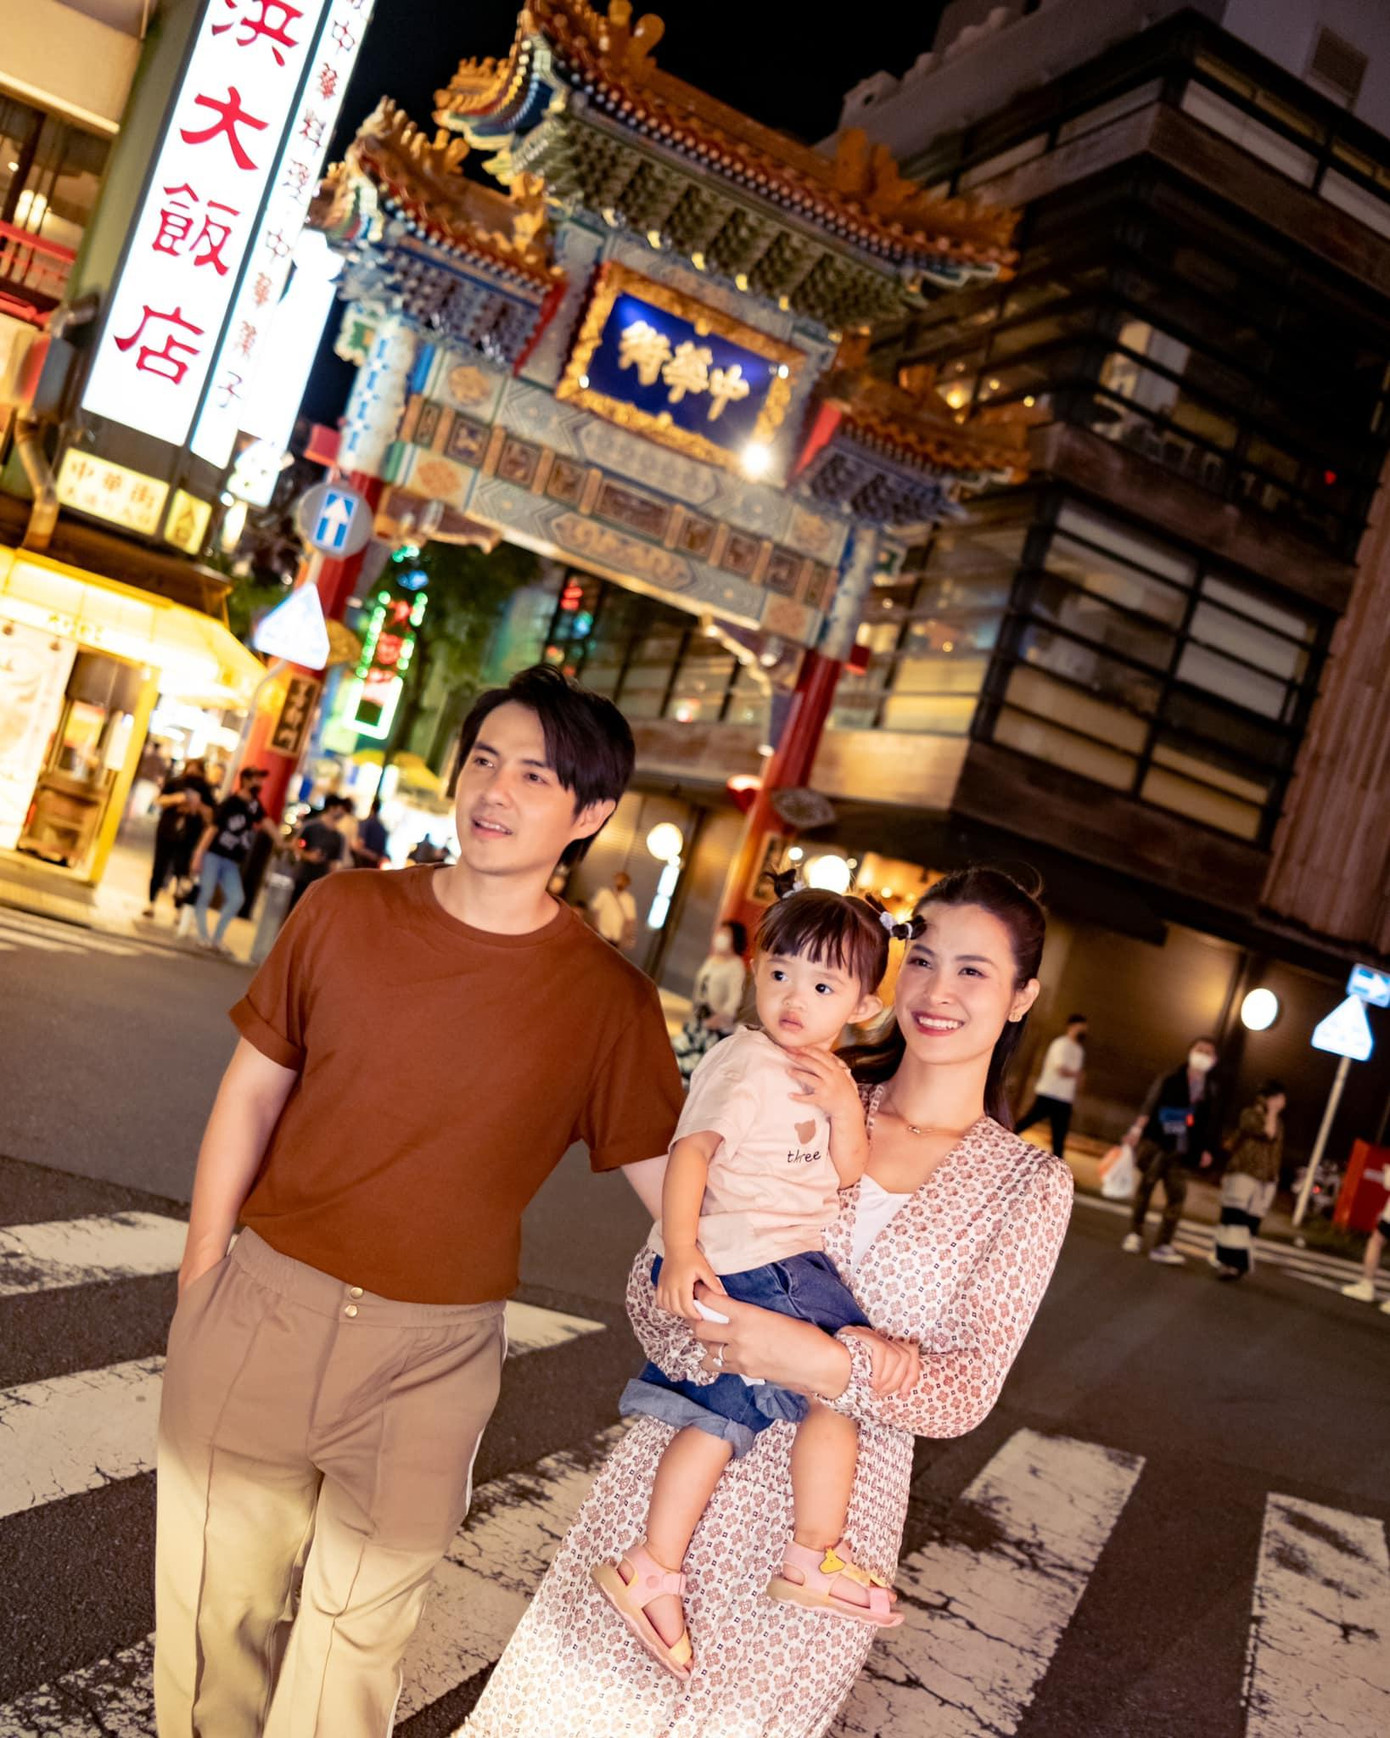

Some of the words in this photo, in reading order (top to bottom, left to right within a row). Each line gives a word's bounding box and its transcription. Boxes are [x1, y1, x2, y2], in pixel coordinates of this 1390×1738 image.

[113, 0, 304, 385] 浜大飯店
[786, 1149, 822, 1163] three
